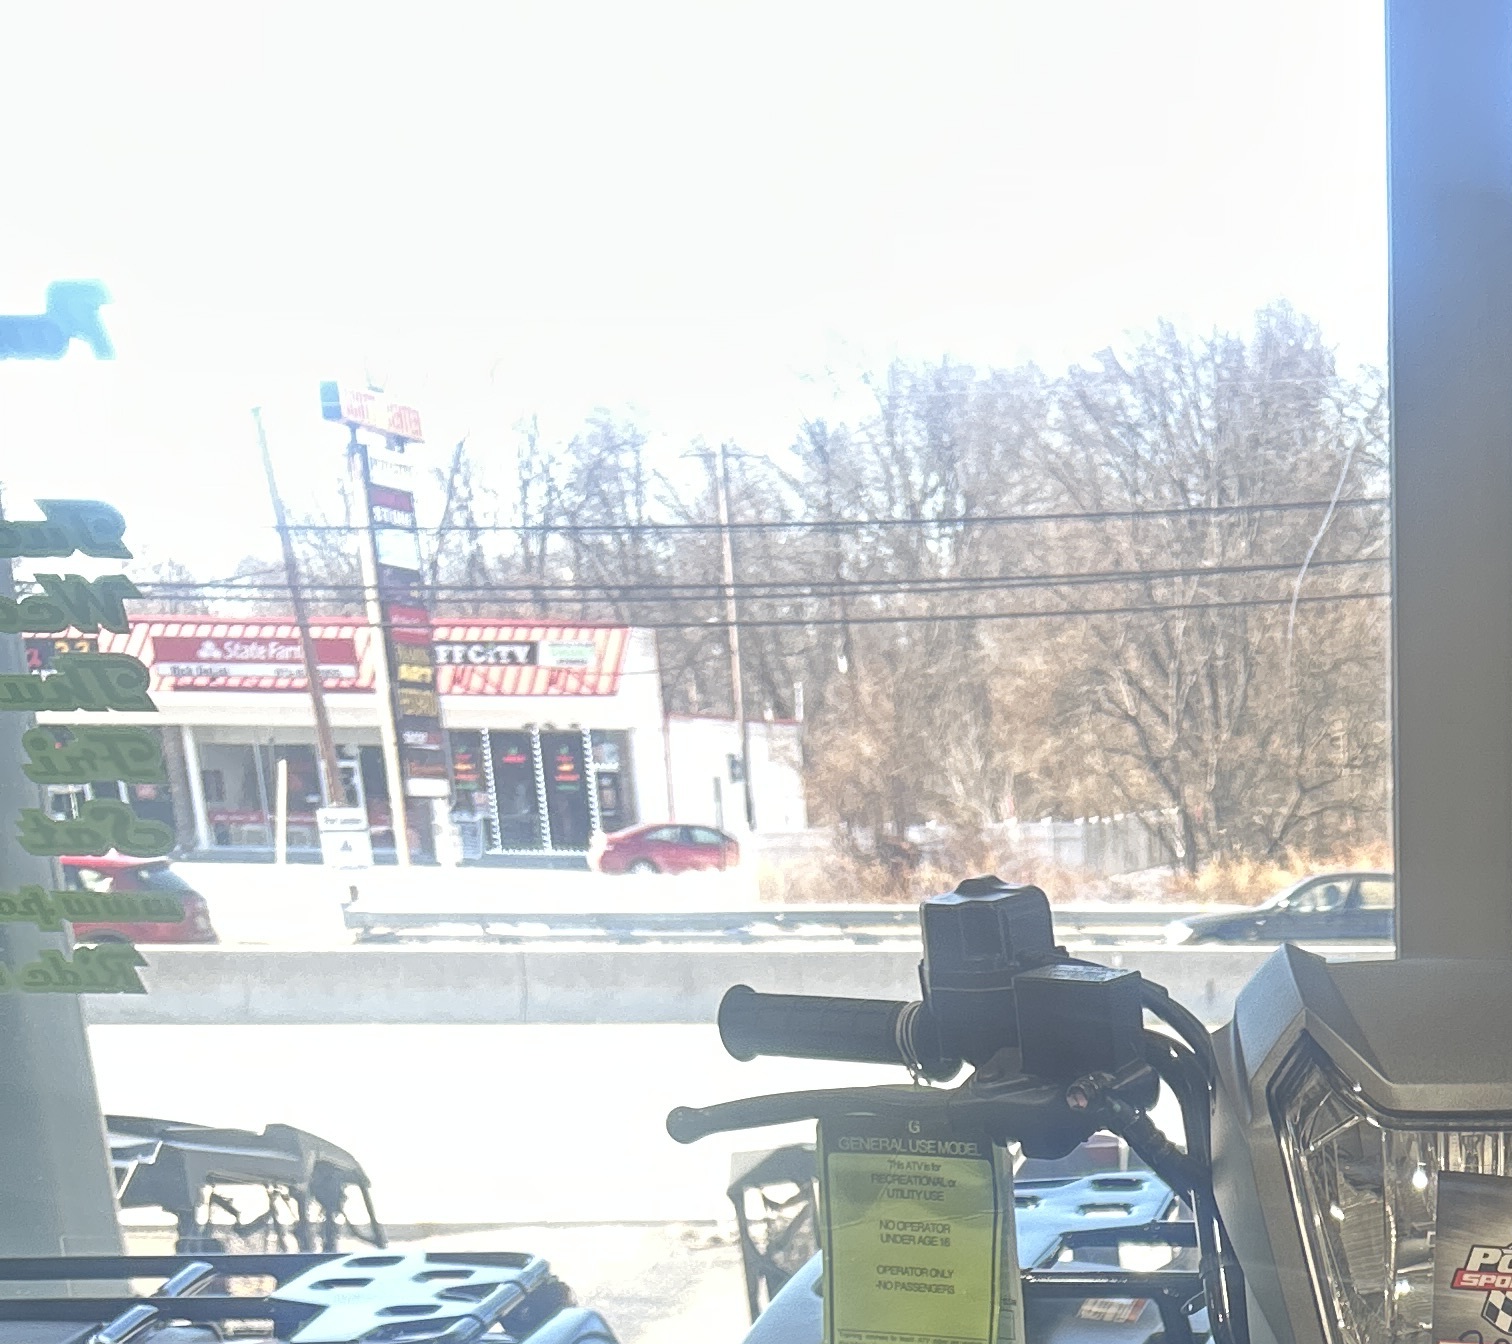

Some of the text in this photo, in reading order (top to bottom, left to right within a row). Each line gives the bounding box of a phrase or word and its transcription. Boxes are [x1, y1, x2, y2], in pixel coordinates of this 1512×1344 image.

[223, 640, 267, 661] State
[908, 1119, 921, 1135] G
[838, 1136, 982, 1156] GENERAL USE MODEL
[871, 1173, 948, 1188] RECREATIONAL
[887, 1189, 945, 1202] UTILITY USE
[880, 1220, 951, 1234] NO OPERATOR
[880, 1233, 915, 1245] UNDER
[917, 1235, 939, 1247] AGE
[876, 1264, 955, 1279] OPERATOR ONLY
[894, 1281, 955, 1295] PASSENGERS
